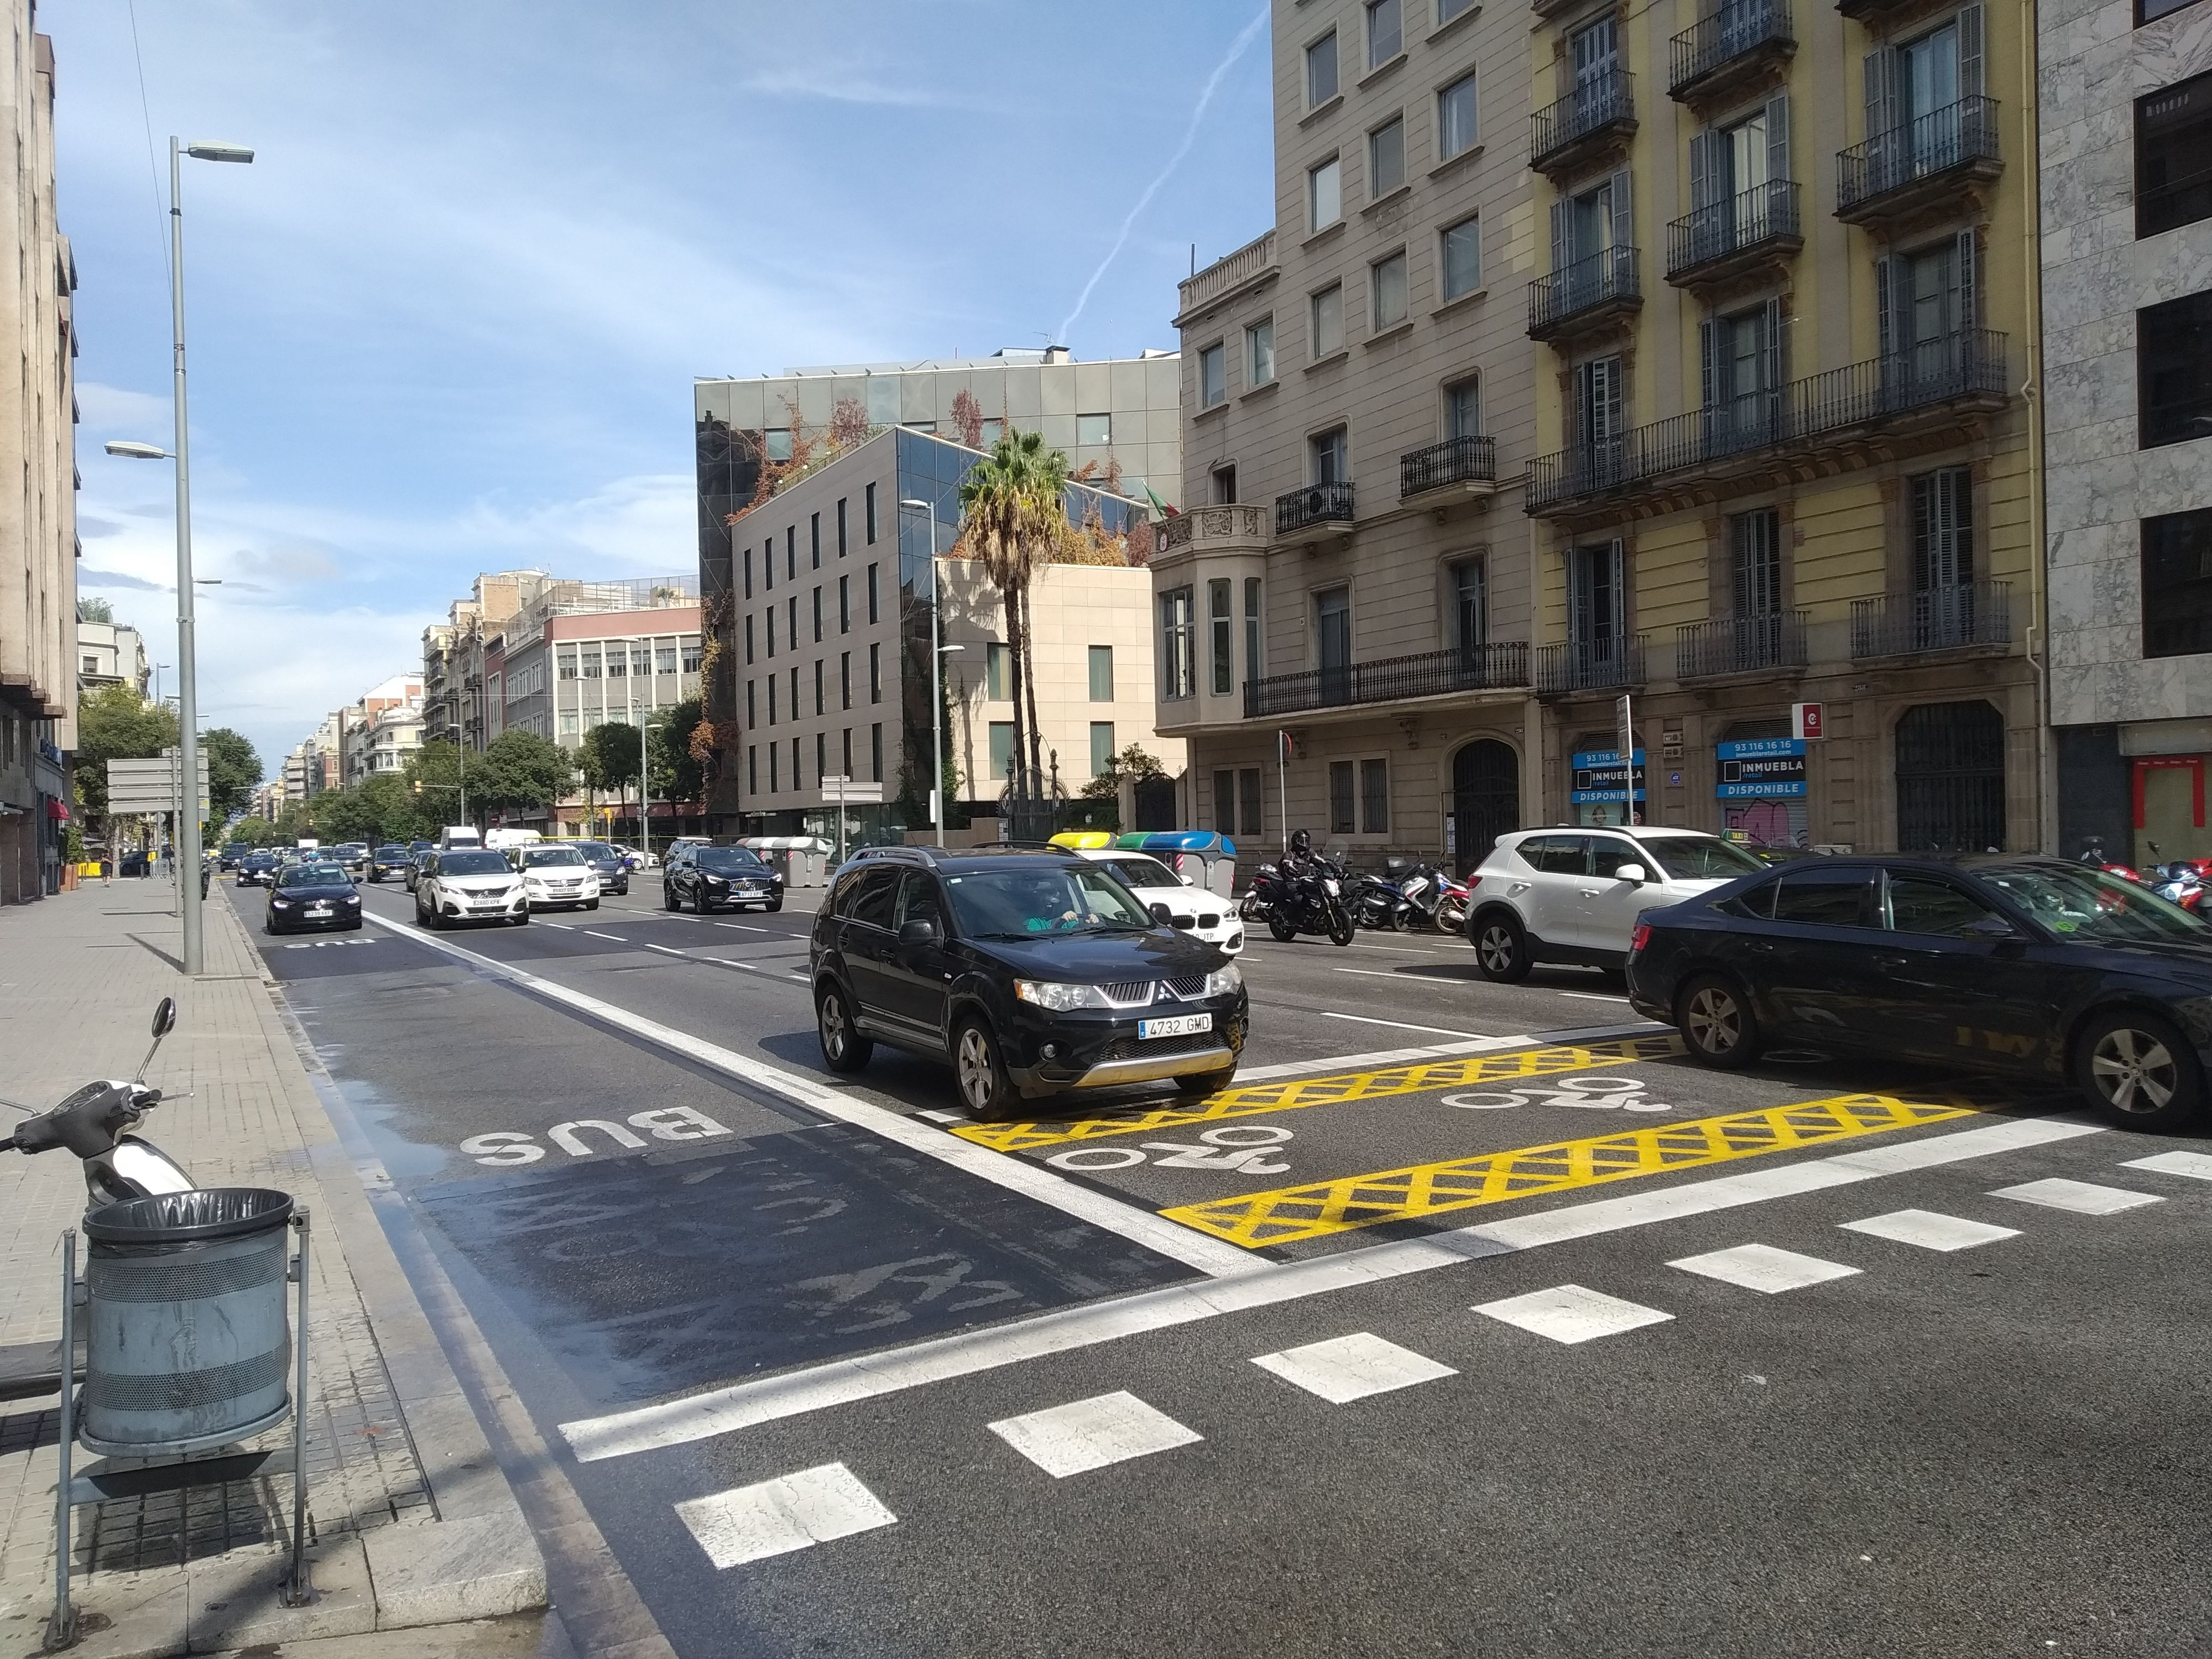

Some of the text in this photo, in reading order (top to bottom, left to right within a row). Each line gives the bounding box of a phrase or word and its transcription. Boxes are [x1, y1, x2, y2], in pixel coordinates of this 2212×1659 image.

[1749, 742, 1764, 750] 116
[1743, 761, 1804, 773] INMUEBLA
[1728, 784, 1799, 795] DISPONIBLE
[1580, 791, 1638, 801] DISPONIBE
[1150, 1016, 1209, 1035] 4732 GMD
[459, 1106, 734, 1166] BUS
